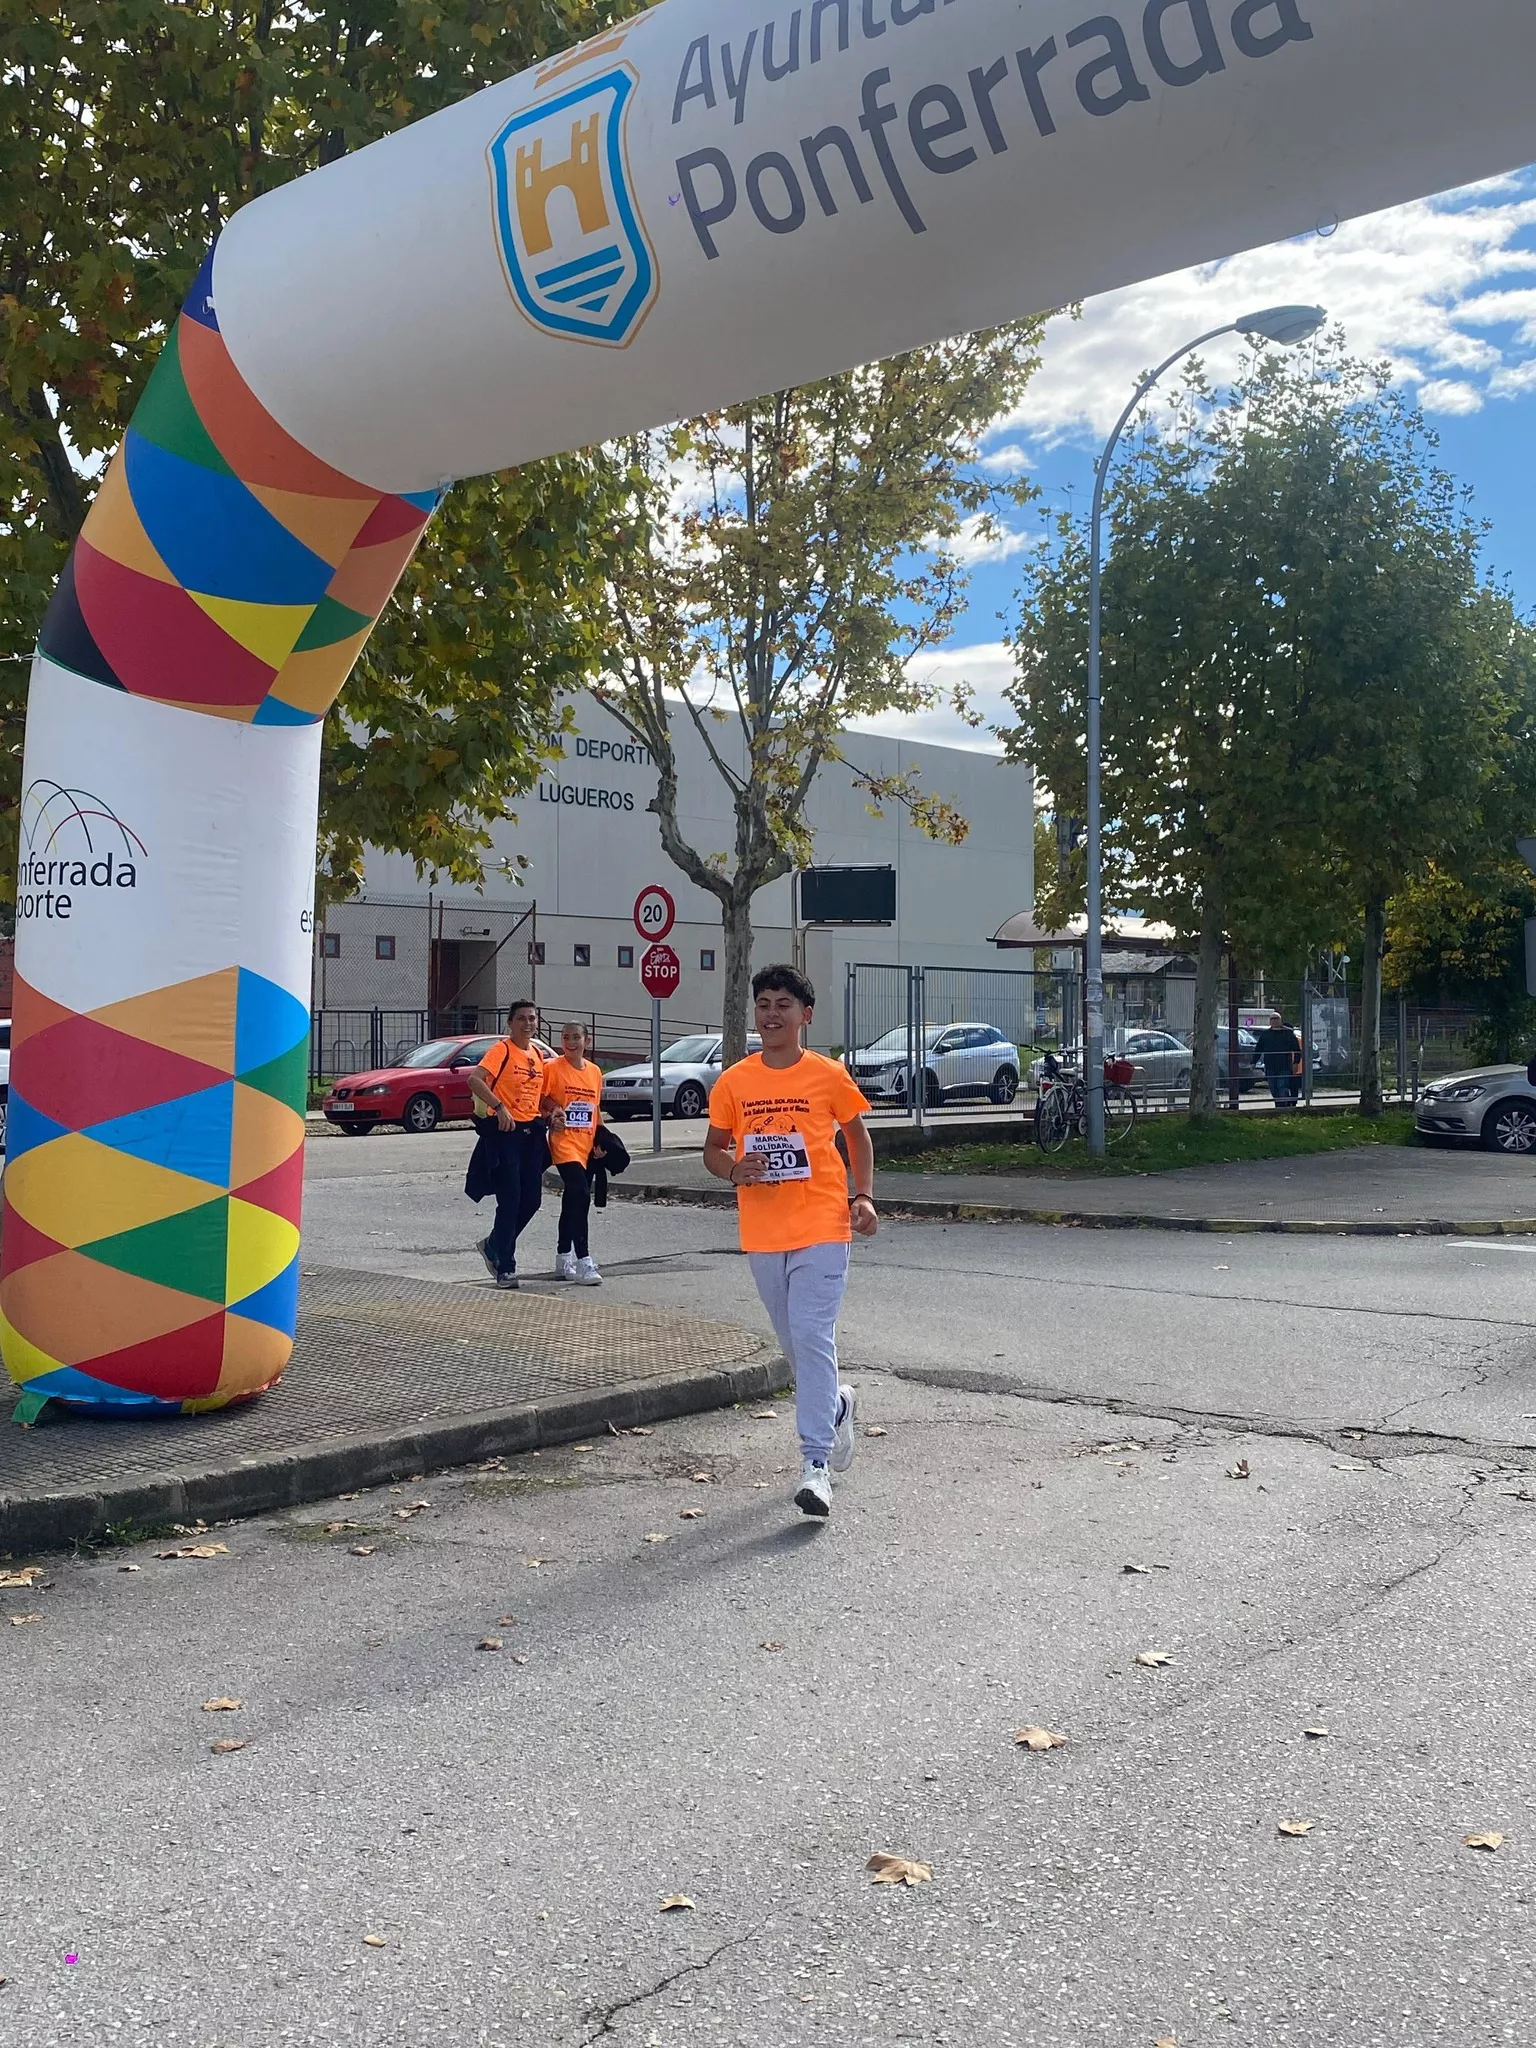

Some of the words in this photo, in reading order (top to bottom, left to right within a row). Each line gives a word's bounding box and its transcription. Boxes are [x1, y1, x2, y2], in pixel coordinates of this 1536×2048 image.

[676, 0, 1314, 260] Ponferrada
[576, 737, 651, 766] DEPORTI
[540, 782, 634, 811] LUGUEROS
[643, 904, 662, 923] 20
[644, 965, 678, 978] STOP
[569, 1112, 589, 1121] 048
[752, 1142, 795, 1152] SOLIDARIA
[755, 1135, 789, 1143] MARCHA
